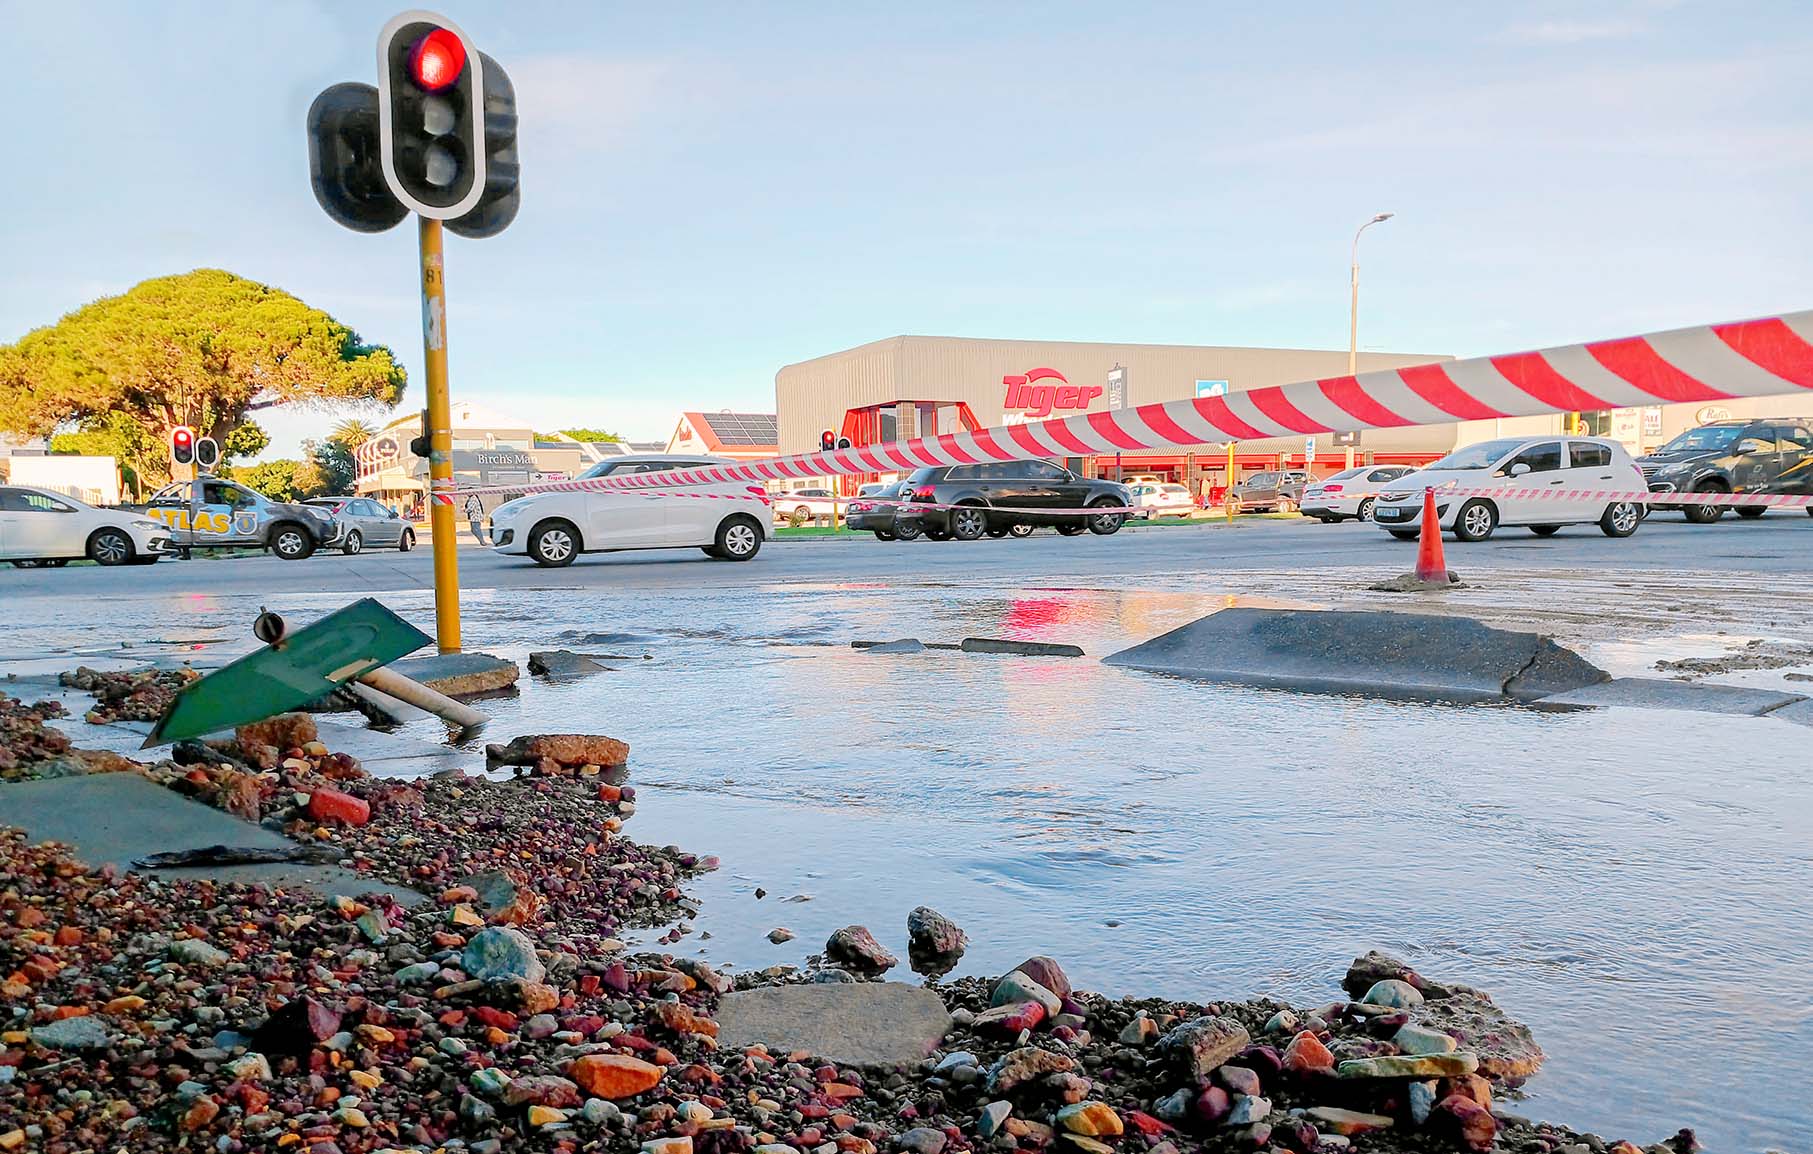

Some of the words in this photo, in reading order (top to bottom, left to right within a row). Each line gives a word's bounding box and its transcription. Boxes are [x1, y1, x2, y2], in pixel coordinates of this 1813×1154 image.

[1002, 367, 1103, 417] Tiger
[478, 454, 513, 465] Birch's
[515, 454, 538, 465] Man
[547, 473, 566, 481] Tiger
